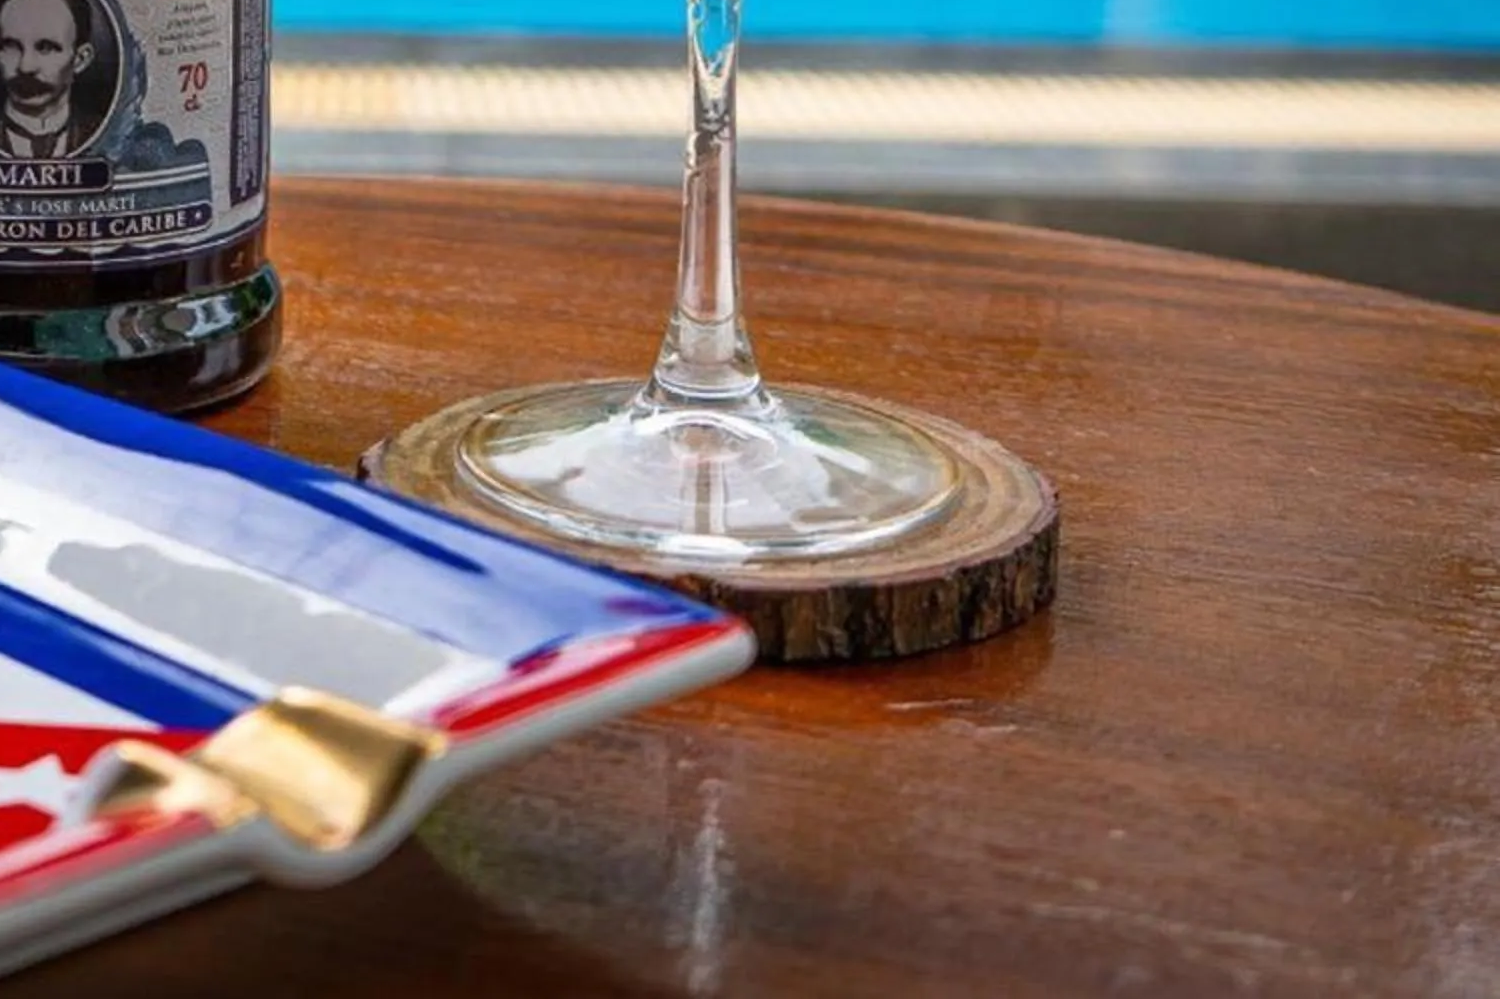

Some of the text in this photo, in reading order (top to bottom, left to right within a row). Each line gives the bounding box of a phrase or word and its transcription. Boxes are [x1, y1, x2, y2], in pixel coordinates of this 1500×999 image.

[177, 62, 208, 94] 70
[56, 220, 102, 239] DEL
[108, 209, 187, 237] CARIBE
